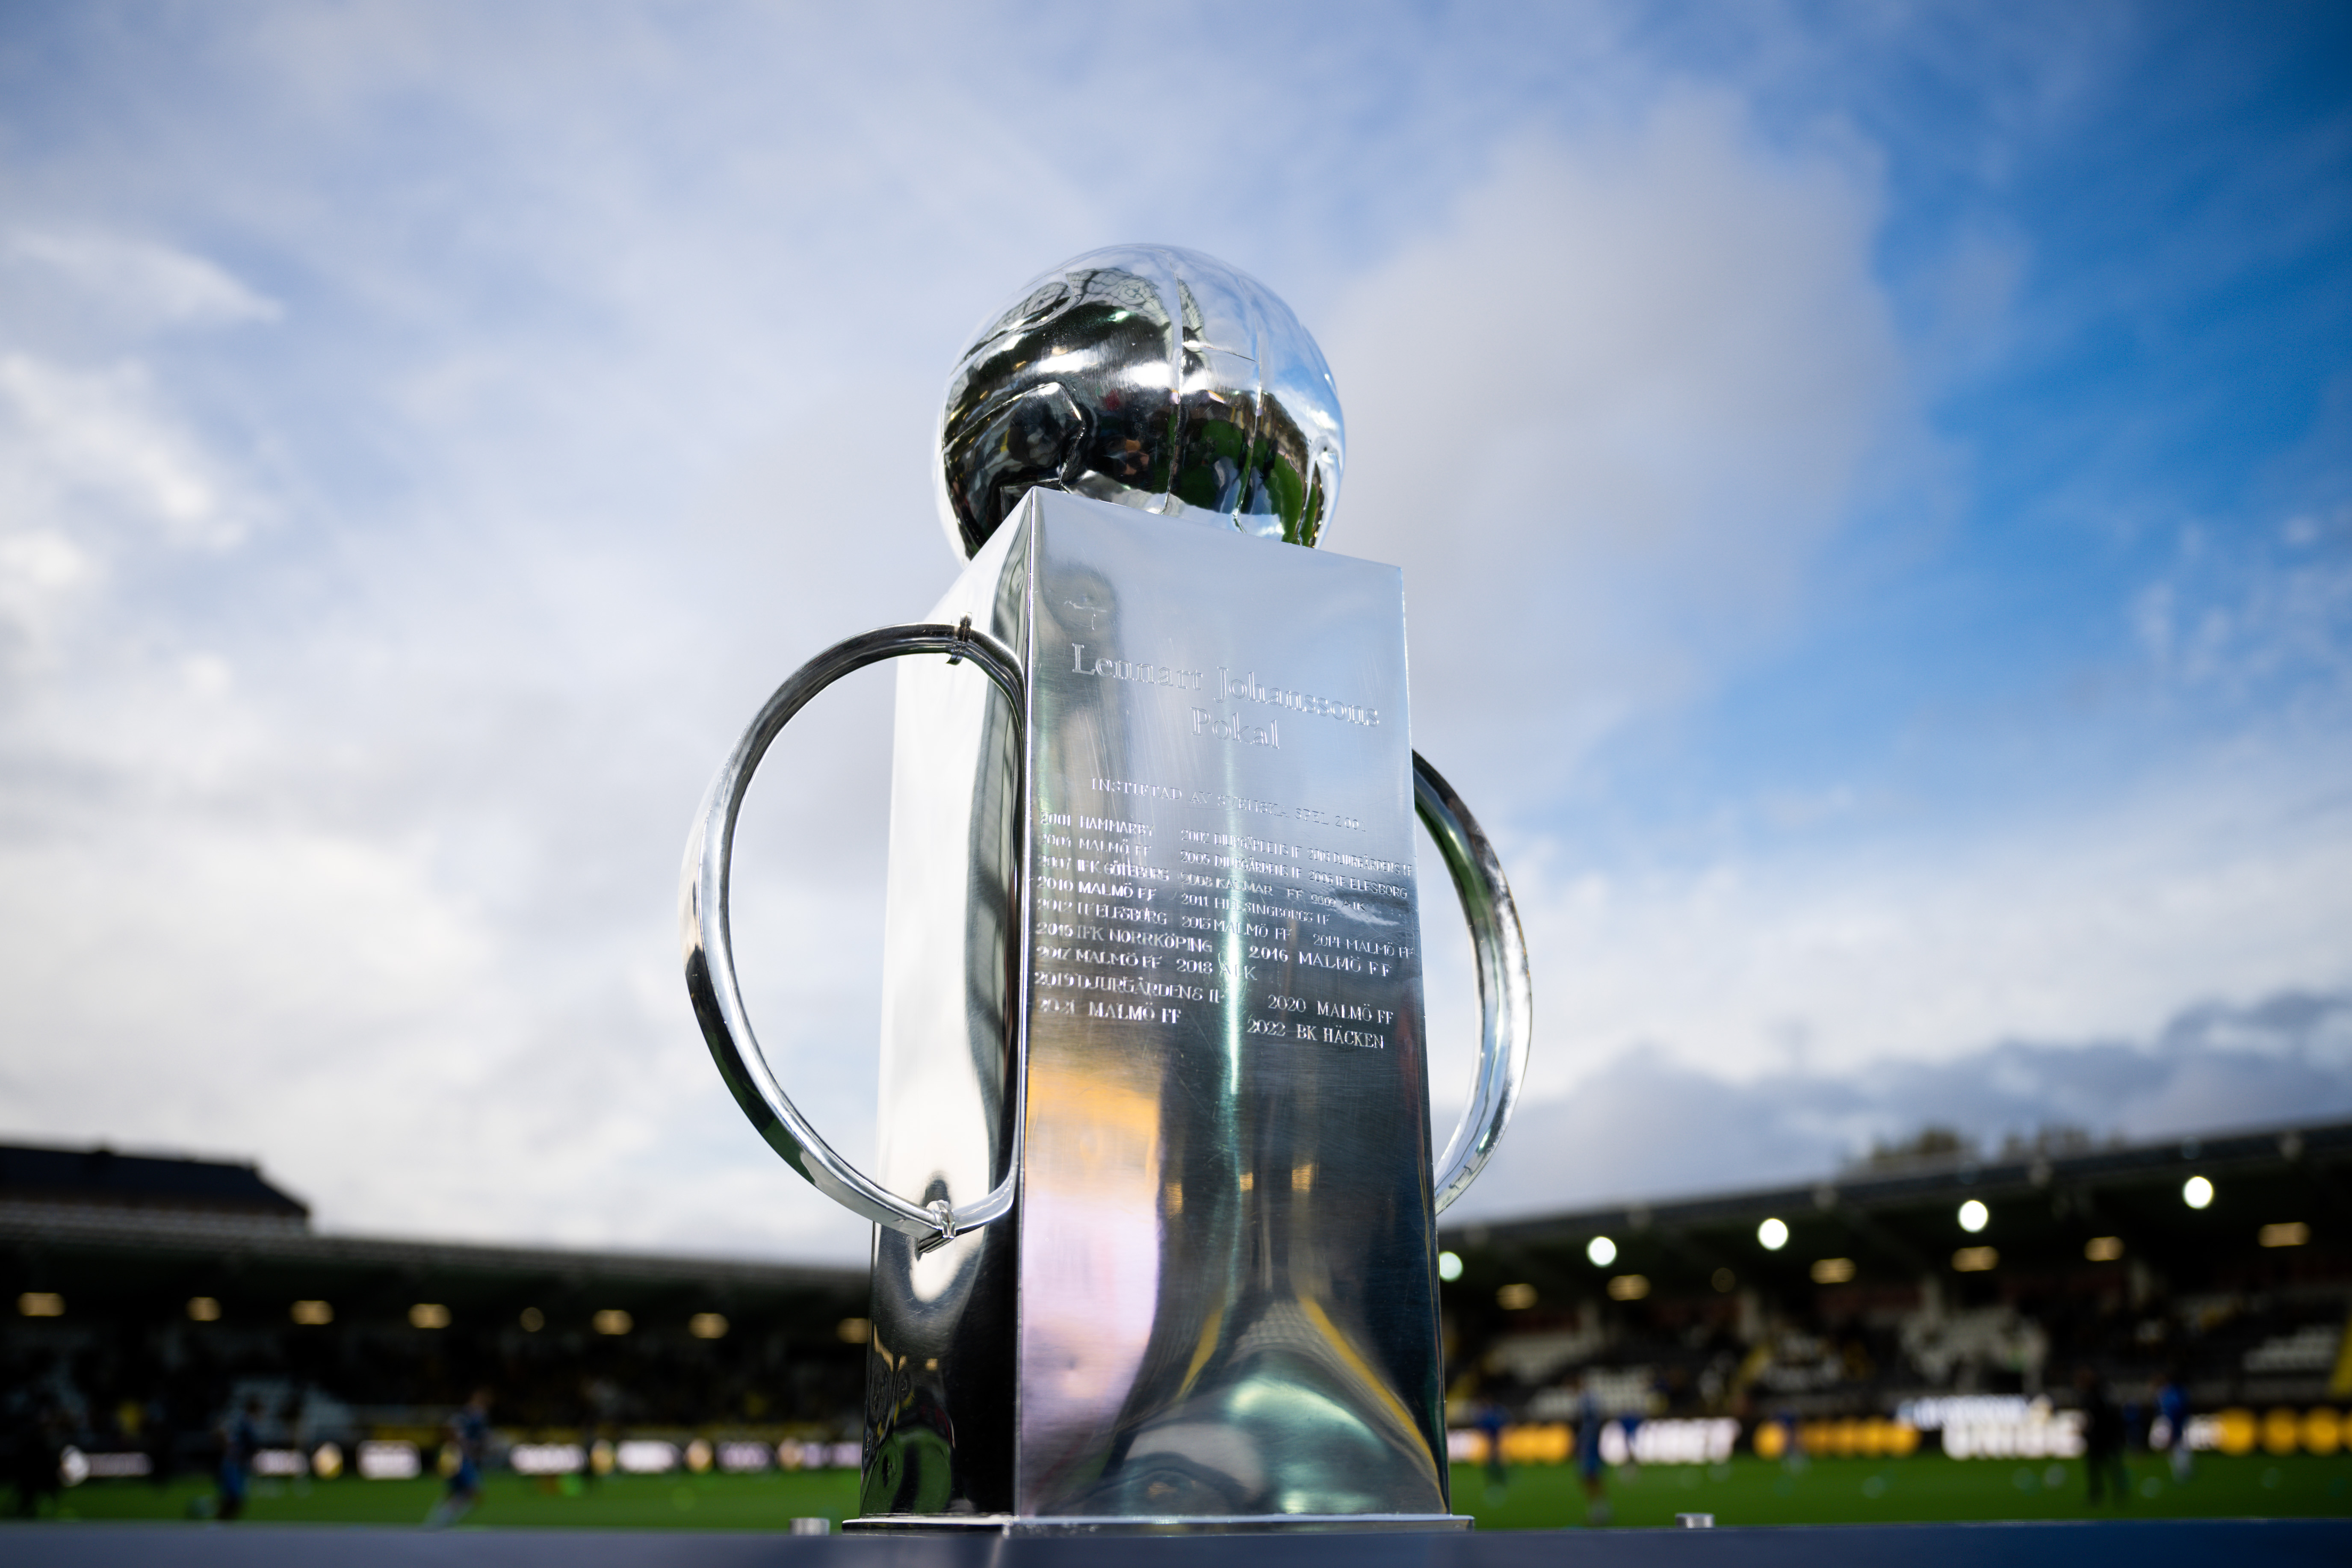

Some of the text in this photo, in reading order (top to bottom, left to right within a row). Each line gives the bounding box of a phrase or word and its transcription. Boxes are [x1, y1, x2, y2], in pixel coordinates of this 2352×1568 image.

[1072, 643, 1379, 727] Lennart Johanssons
[1190, 707, 1279, 749] Pokal
[1091, 777, 1366, 832] INSTIFTAD AV SVENSKA SPEL 2001
[1040, 811, 1155, 836] 2001 HAMMARBY
[1039, 833, 1152, 856] 2004 MALMÖ FF
[1181, 829, 1209, 843] 2002
[1291, 846, 1302, 858] IF
[1077, 859, 1102, 874] IFK
[1180, 850, 1210, 864] 2005
[1292, 867, 1302, 878] IF
[1307, 848, 1330, 862] 2003
[1403, 864, 1412, 876] IF
[1037, 876, 1157, 901] 2010 MALMÖ FF
[1216, 877, 1273, 896] KALMAR
[1287, 887, 1303, 899] FF
[1308, 870, 1407, 899] 2006 IF ELFSBORG
[1037, 898, 1167, 925] 2012 IF ELFSBORG
[1181, 893, 1209, 907] 2011
[1317, 913, 1330, 925] IF
[1341, 899, 1367, 912] AIK
[1035, 921, 1213, 953] 2015 IFK NORRKÖPING
[1182, 915, 1292, 940] 2013 MALMÖ FF
[1036, 946, 1163, 969] 2017 MALMÖ FF
[1313, 933, 1414, 959] 2014 MALMÖ FF
[1176, 958, 1258, 980] 2018 AIK
[1248, 945, 1392, 977] 2016 MALMÖ FF
[1034, 971, 1074, 987] 2019
[1075, 973, 1203, 1001] DJURGÅRDENS
[1088, 1001, 1155, 1021] MALMÖ
[1161, 1007, 1181, 1024] FF
[1268, 994, 1394, 1024] 2020 MALMÖ FF
[1247, 1019, 1384, 1049] 2022 BK HÄCKEN
